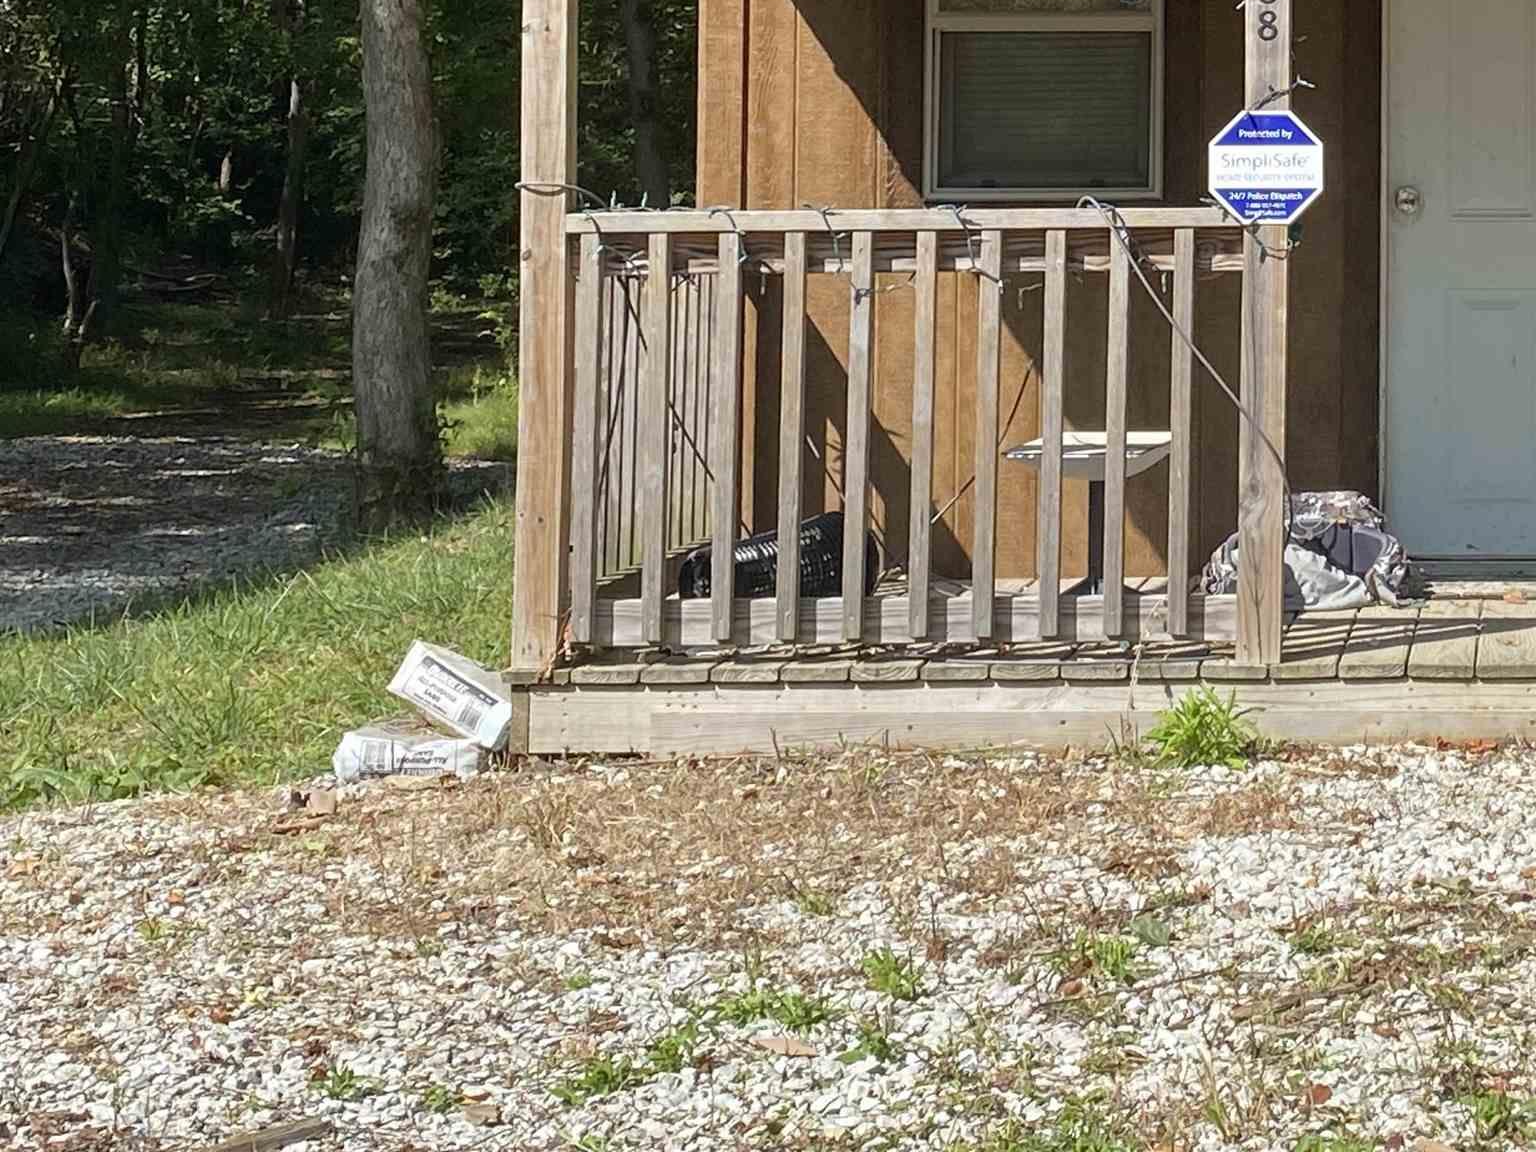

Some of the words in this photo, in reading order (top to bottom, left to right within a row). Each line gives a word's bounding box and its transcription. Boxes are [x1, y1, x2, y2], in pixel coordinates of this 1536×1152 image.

[1238, 129, 1280, 139] Protected
[1281, 129, 1293, 140] by
[1221, 152, 1308, 171] SimpliSafe
[1229, 192, 1246, 200] 24/7
[1247, 192, 1269, 200] Police
[1270, 191, 1303, 202] Dispatch
